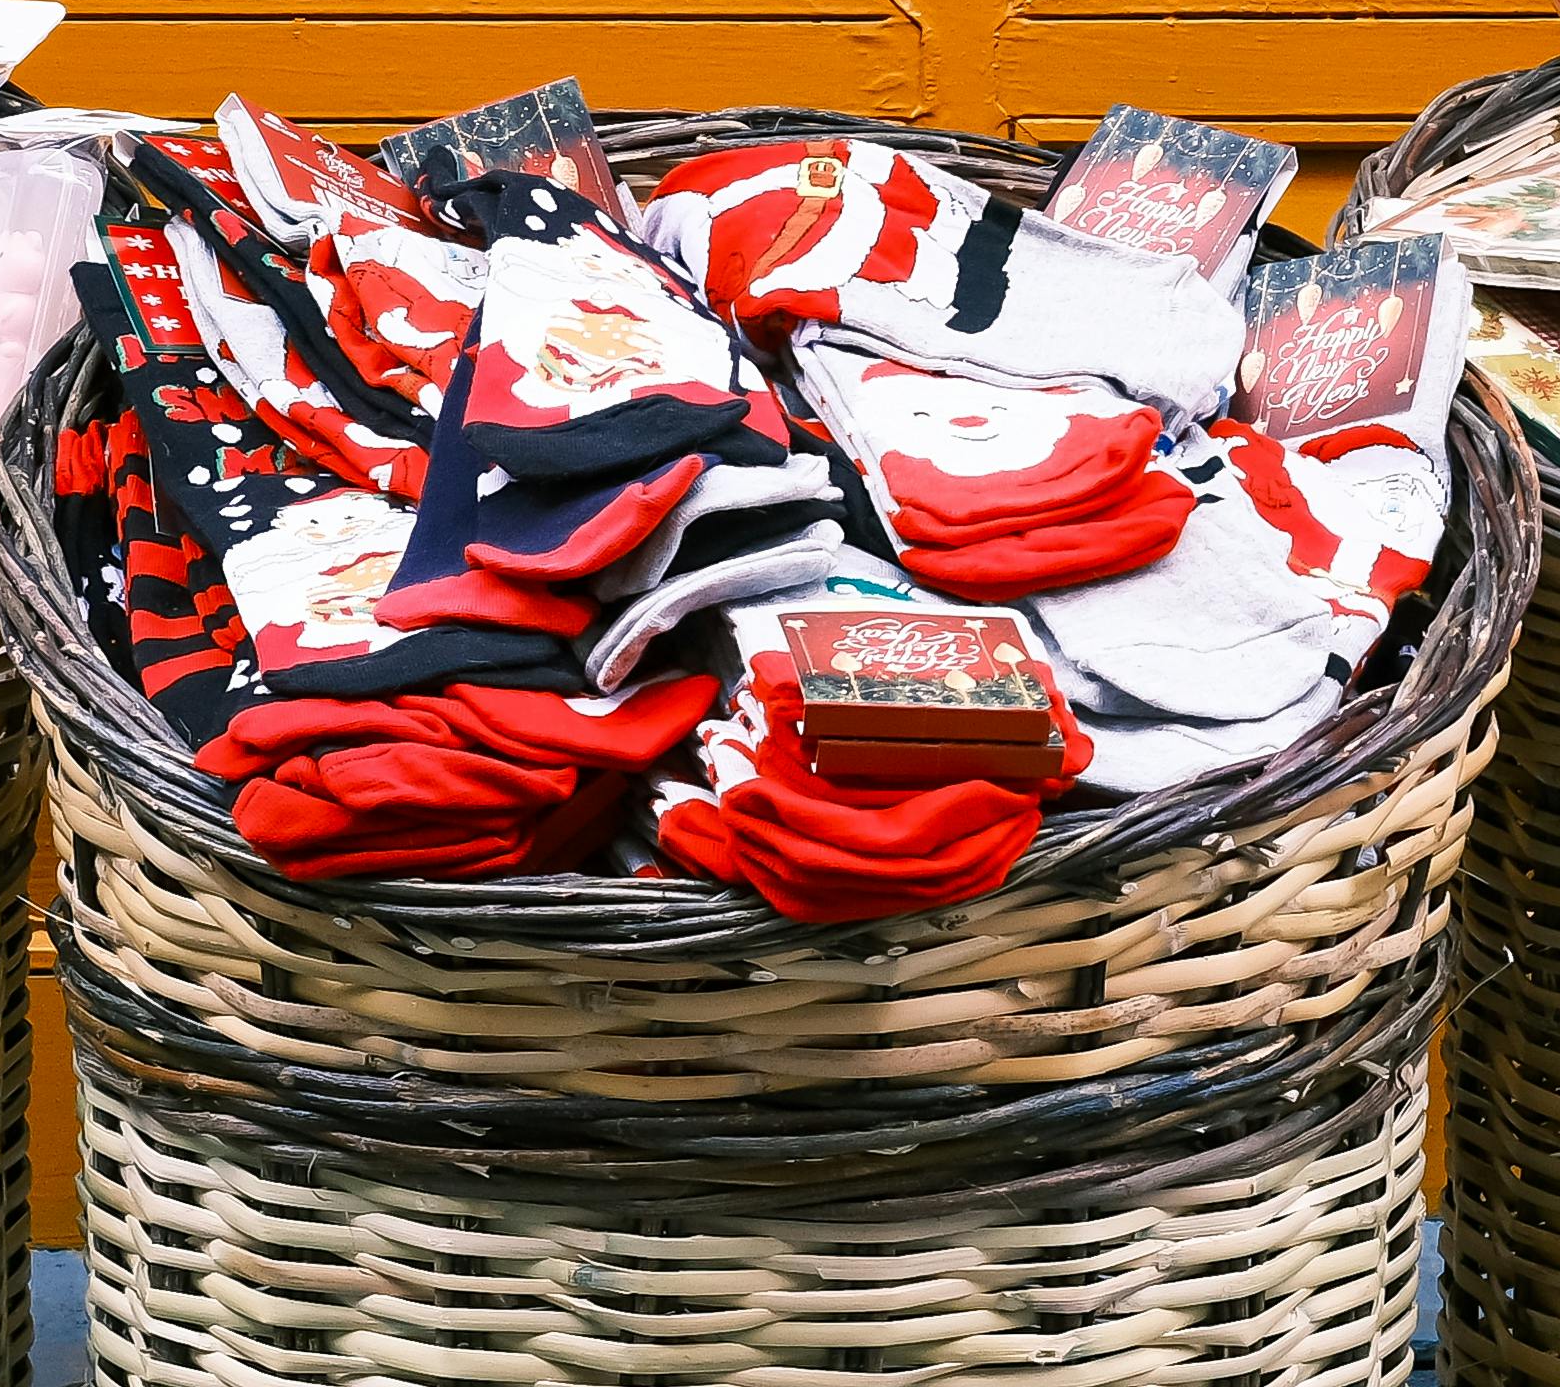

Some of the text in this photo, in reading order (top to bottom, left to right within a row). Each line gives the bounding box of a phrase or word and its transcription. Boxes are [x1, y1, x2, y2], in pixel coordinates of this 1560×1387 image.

[1096, 180, 1202, 235] Happy
[1279, 310, 1385, 360] Happy
[1269, 347, 1389, 385] New
[1267, 373, 1370, 430] Year
